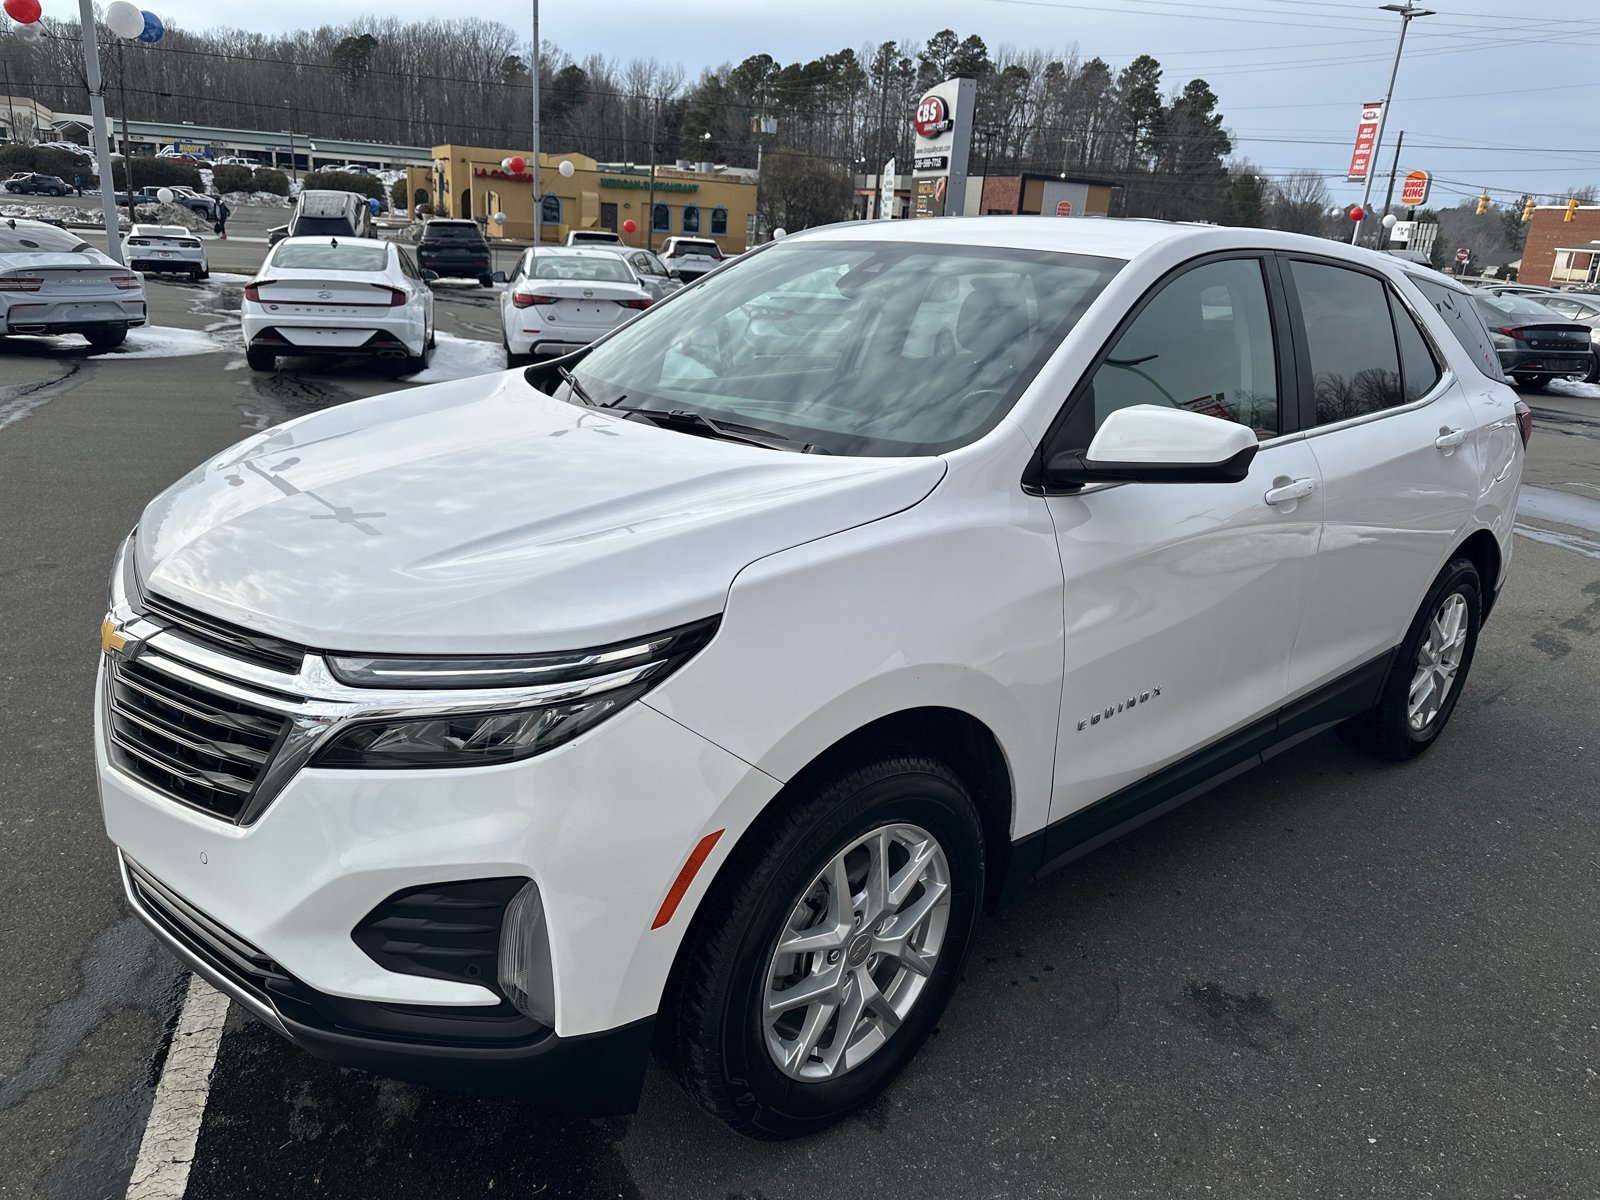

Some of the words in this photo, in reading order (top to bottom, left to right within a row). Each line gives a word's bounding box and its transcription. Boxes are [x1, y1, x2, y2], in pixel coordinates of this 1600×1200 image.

[917, 102, 937, 123] CBS
[474, 167, 487, 176] LA
[643, 181, 699, 193] RSTAURANT
[1402, 188, 1424, 198] KING
[1077, 685, 1162, 731] EQUINOX
